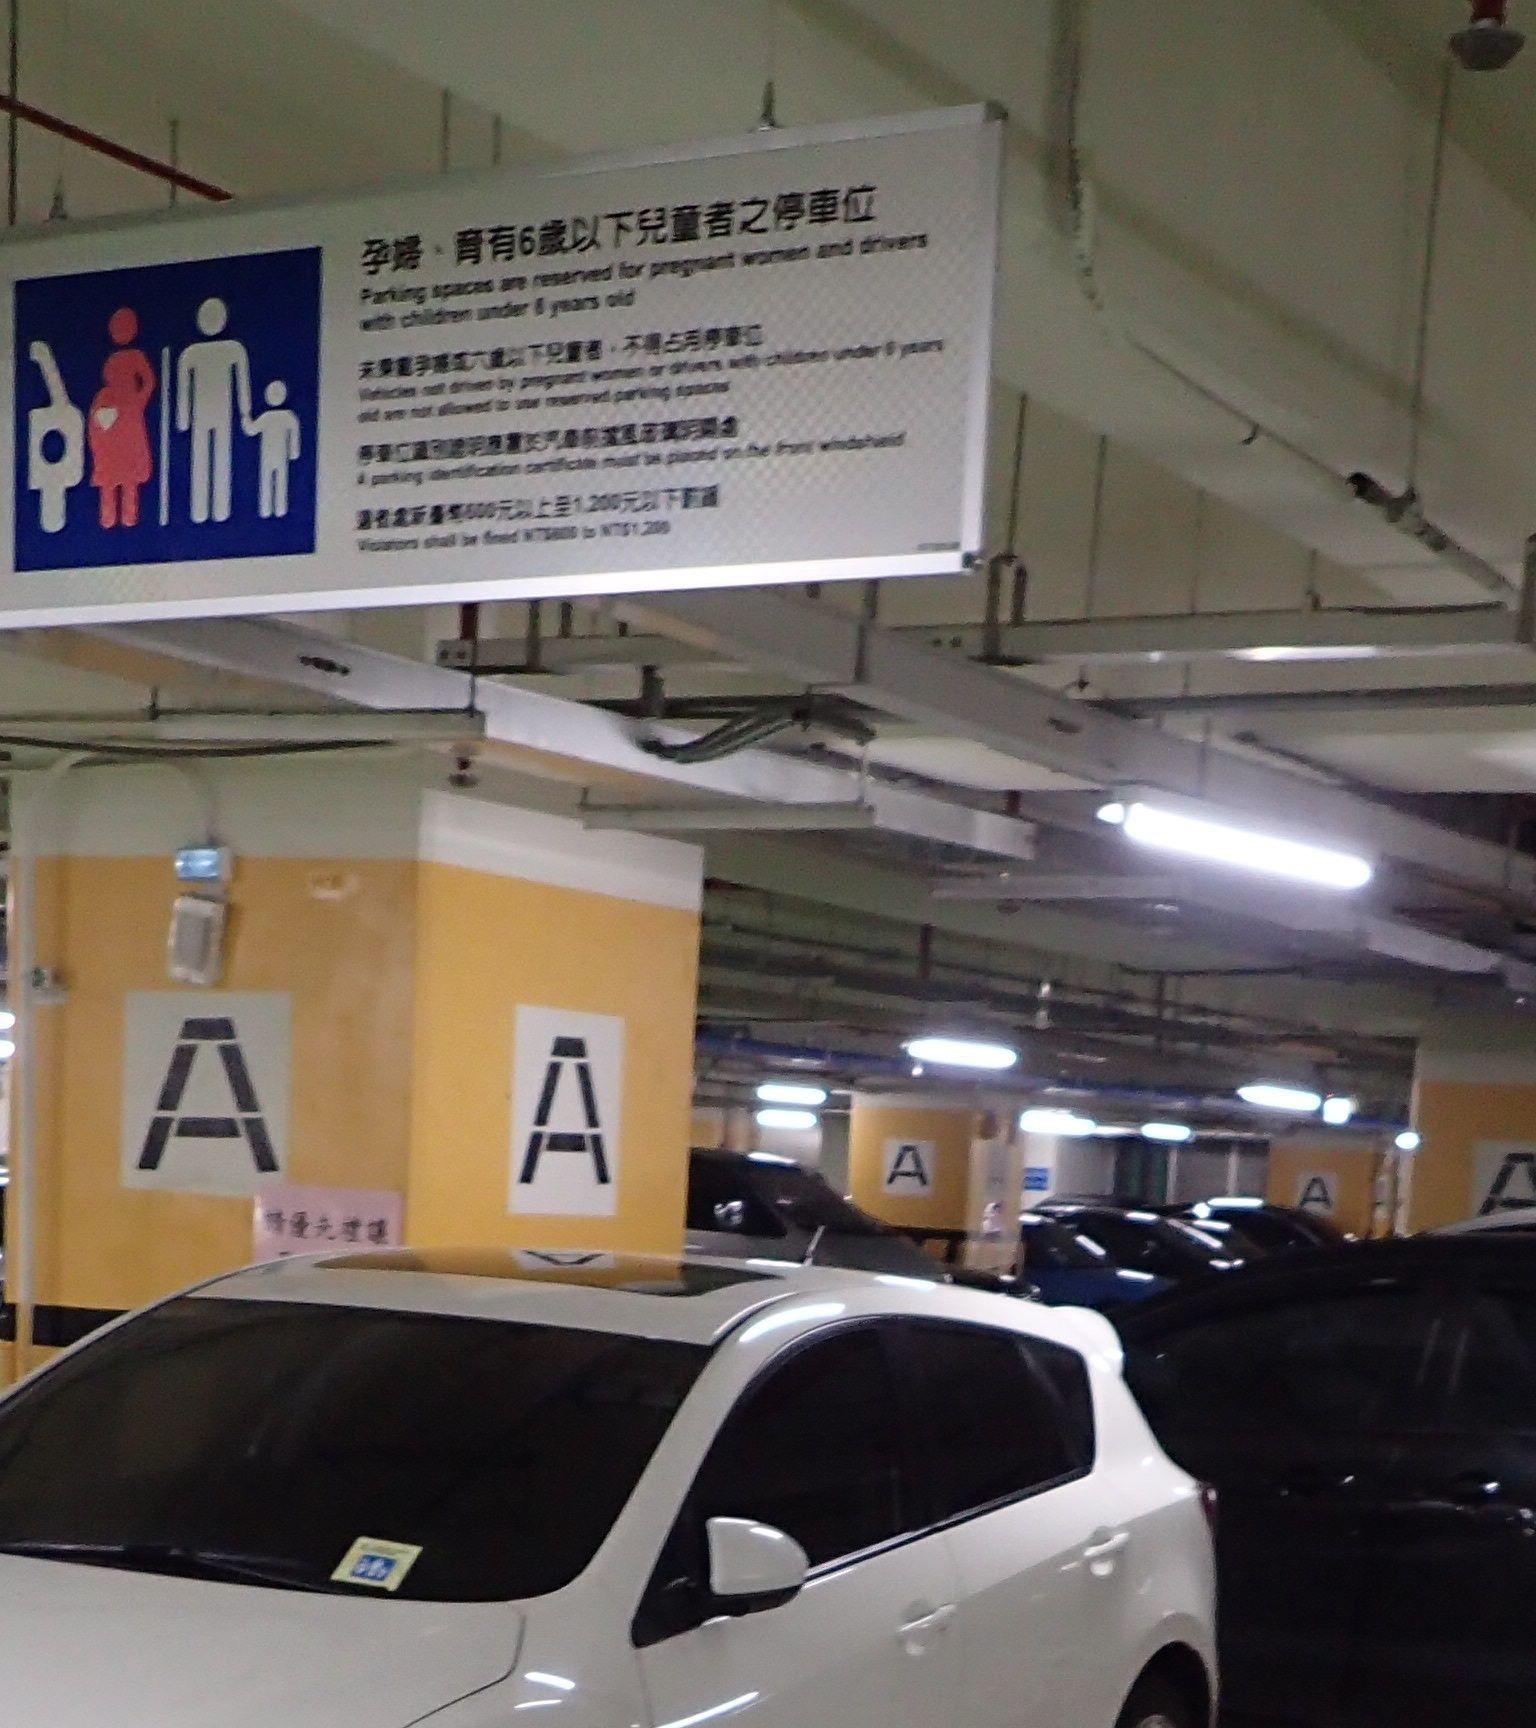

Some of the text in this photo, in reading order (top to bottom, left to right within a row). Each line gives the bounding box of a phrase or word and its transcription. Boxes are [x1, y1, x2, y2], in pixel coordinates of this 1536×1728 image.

[360, 232, 928, 305] Parking spaces are reserved for pregnant women and drivers
[137, 1016, 280, 1173] A
[518, 1035, 611, 1185] A
[886, 1144, 929, 1187] A
[1297, 1175, 1333, 1210] A
